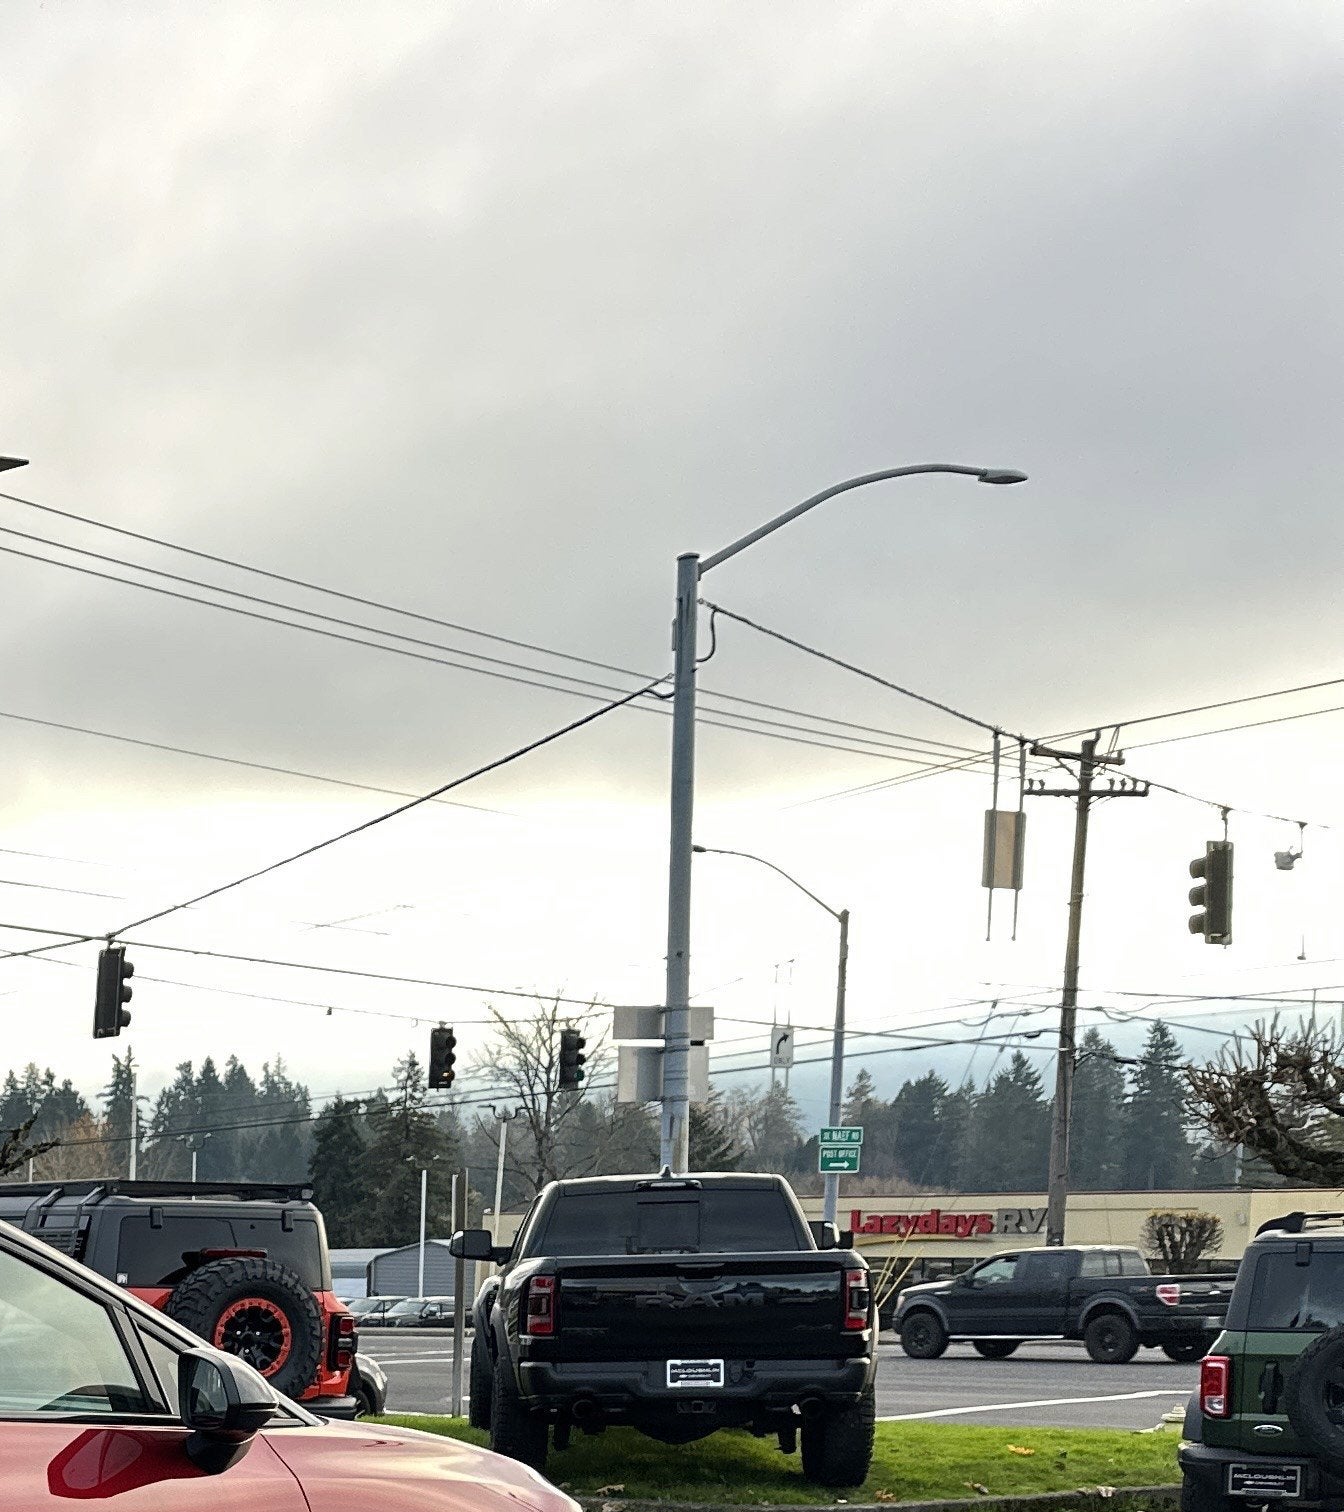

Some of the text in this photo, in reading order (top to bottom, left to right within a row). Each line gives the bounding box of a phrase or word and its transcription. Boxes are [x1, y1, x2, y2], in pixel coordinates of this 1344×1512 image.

[822, 1149, 838, 1158] POST
[850, 1207, 1050, 1238] Lazydays RV
[635, 1292, 765, 1309] RAM
